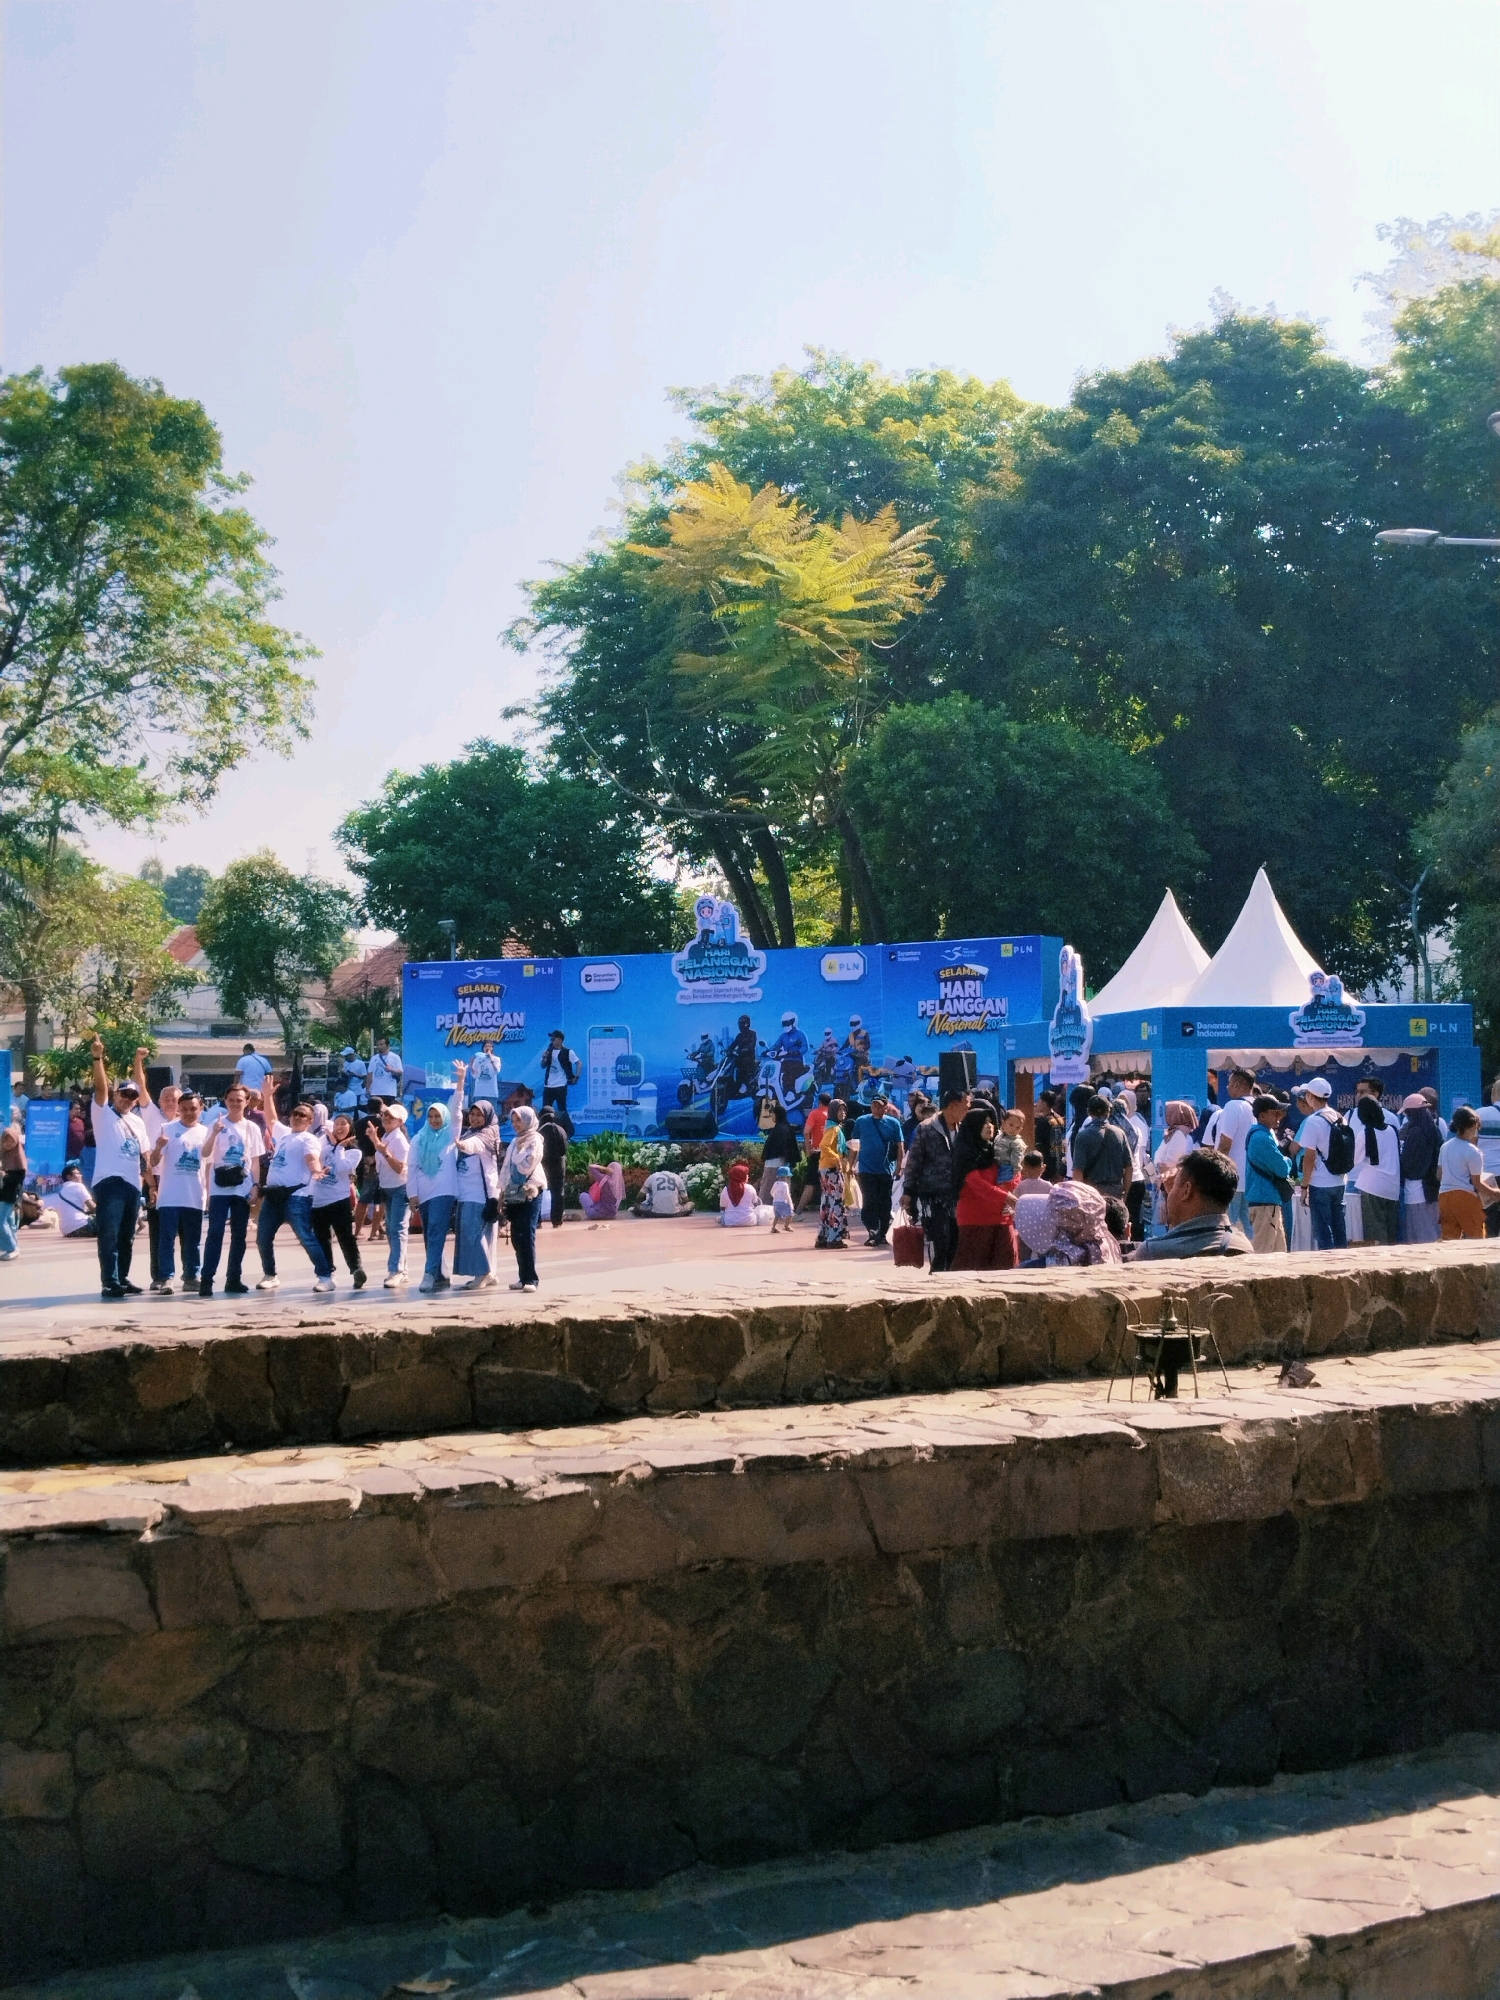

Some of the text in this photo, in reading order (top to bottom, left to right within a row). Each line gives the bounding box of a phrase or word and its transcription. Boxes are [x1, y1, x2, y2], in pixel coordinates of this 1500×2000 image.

[704, 949, 730, 957] HARI
[1014, 946, 1032, 954] PLN
[676, 956, 760, 970] PELANGGAN
[839, 962, 860, 970] PLN
[535, 966, 554, 974] PLN
[682, 967, 754, 981] NASIONAL
[458, 984, 500, 996] SELAMAT
[940, 980, 981, 998] HARI
[458, 996, 500, 1012] HARI
[918, 998, 1006, 1017] PELANGGAN
[436, 1012, 525, 1030] PELANGGAN
[926, 1010, 988, 1036] Nasional
[1294, 1014, 1361, 1023] PELANGGAN
[1300, 1022, 1356, 1031] NASIONAL
[1430, 1023, 1458, 1032] PLN
[444, 1024, 504, 1046] Nasional
[656, 1178, 676, 1191] 29
